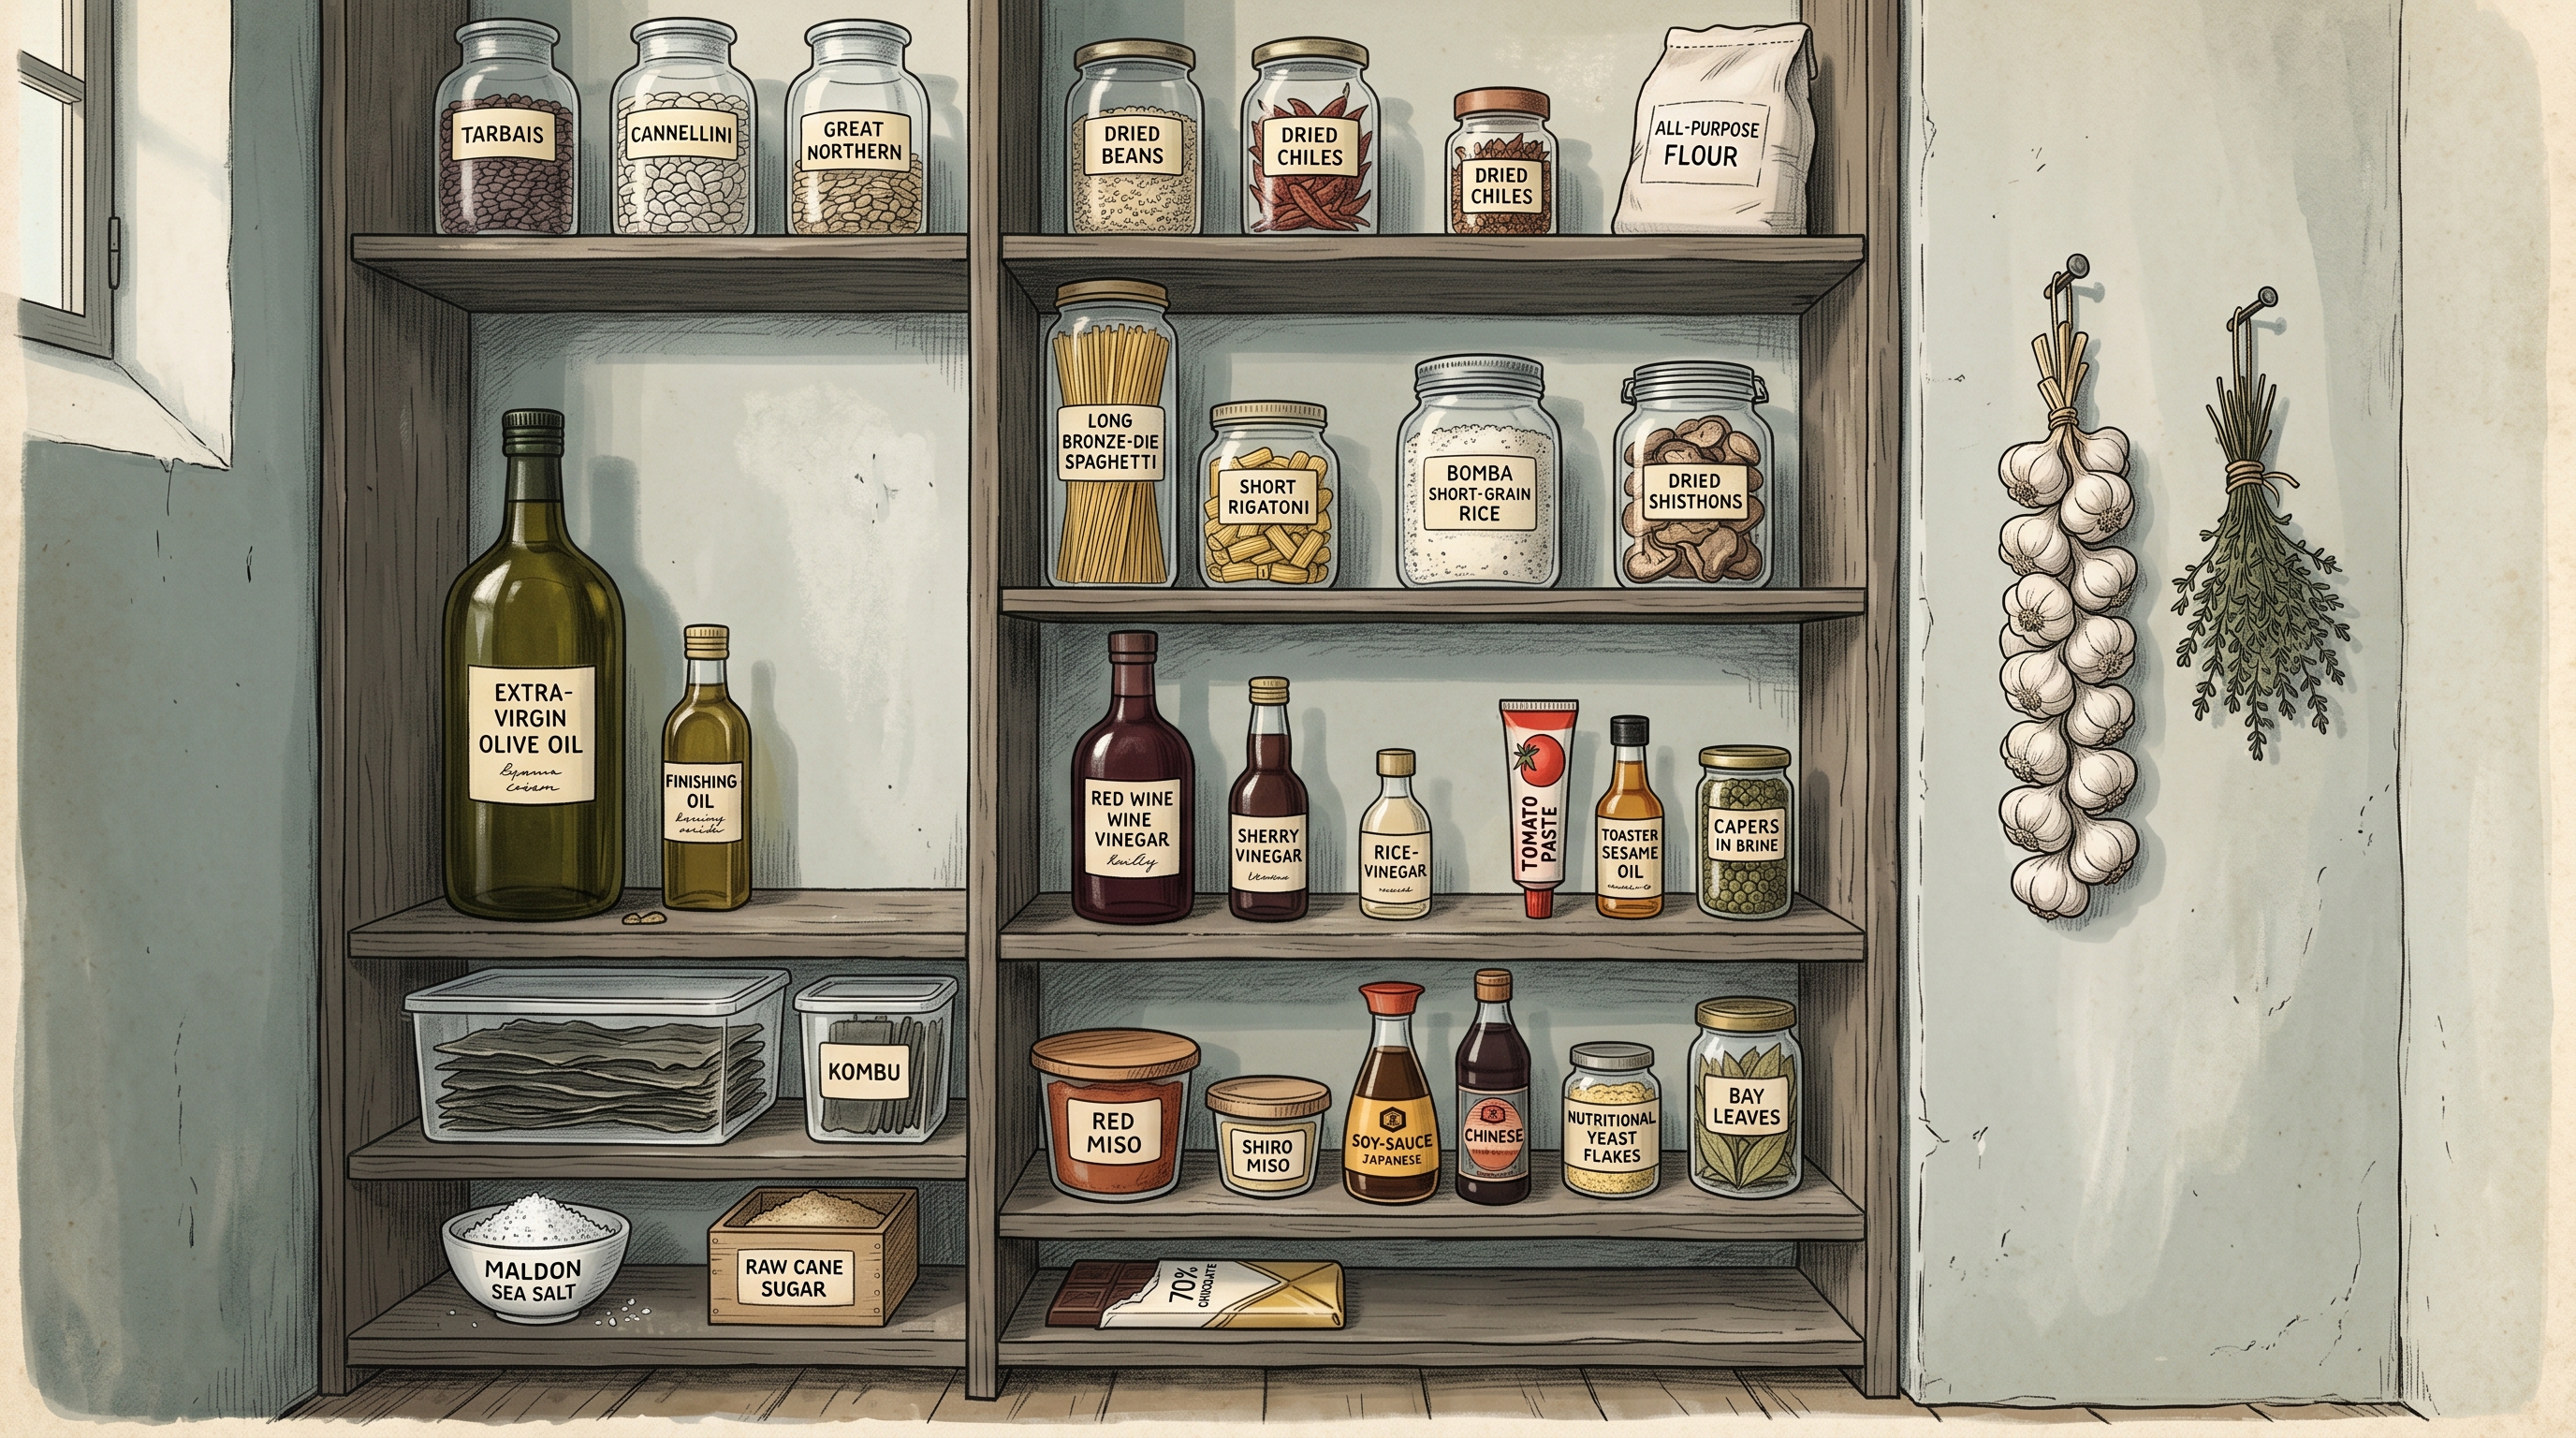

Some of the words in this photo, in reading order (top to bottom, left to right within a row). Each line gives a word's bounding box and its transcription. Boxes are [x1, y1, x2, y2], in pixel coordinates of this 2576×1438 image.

[461, 125, 544, 144] TARBAIS
[631, 125, 732, 144] CANNELLINI
[824, 120, 885, 138] GREAT
[1105, 125, 1160, 142] DRIED
[1281, 126, 1338, 143] DRIED
[1654, 120, 1760, 139] ALL-PURPOSE
[807, 142, 901, 161] NORTHERN
[1102, 147, 1164, 165] BEANS
[1277, 149, 1343, 167] CHILES
[1664, 143, 1738, 168] FLOUR
[1475, 167, 1528, 183] DRIED
[1471, 188, 1533, 205] CHILES
[1088, 413, 1133, 429] LONG
[1062, 433, 1159, 449] BRONZE-DIE
[1065, 453, 1157, 470] SPAGHETTI
[1447, 464, 1514, 482] BOMBA
[1669, 473, 1721, 489] DRIED
[1239, 478, 1296, 495] SHORT
[1428, 487, 1531, 501] SHORT-GRAIN
[1228, 499, 1310, 515] RIGATONI
[1648, 493, 1743, 509] SHISTHONS
[1459, 505, 1500, 521] RICE
[495, 682, 573, 702] EXTRA-
[494, 709, 566, 728] VIRGIN
[478, 734, 539, 755] OLIVE
[548, 735, 584, 755] OIL
[666, 773, 738, 789] FINISHING
[687, 793, 715, 809] OIL
[1091, 790, 1124, 807] RED
[1130, 790, 1174, 807] WINE
[1107, 812, 1151, 828] WINE
[1714, 818, 1779, 834] CAPERS
[1094, 831, 1170, 847] VINEGAR
[1237, 828, 1300, 844] SHERRY
[1521, 796, 1538, 873] TOMATO
[1540, 806, 1558, 862] PASTE
[1601, 828, 1659, 843] TOASTER
[1374, 844, 1419, 860] RICE-
[1602, 845, 1659, 860] SESAME
[1716, 837, 1731, 852] IN
[1736, 838, 1778, 853] BRINE
[1235, 847, 1303, 864] VINEGAR
[1364, 863, 1427, 879] VINEGAR
[1617, 864, 1645, 879] OIL
[828, 1062, 900, 1081] KOMBU
[1729, 1087, 1765, 1105] BAY
[1092, 1111, 1134, 1131] RED
[1568, 1109, 1657, 1127] NUTRITIONAL
[1714, 1108, 1781, 1126] LEAVES
[1352, 1131, 1434, 1152] SOY-SAUCE
[1462, 1125, 1526, 1146] CHINESE
[1587, 1130, 1638, 1146] YEAST
[1087, 1135, 1142, 1154] MISO
[1242, 1139, 1293, 1155] SHIRO
[1362, 1153, 1423, 1167] JAPANESE
[1584, 1148, 1641, 1164] FLAKES
[1247, 1158, 1290, 1173] MISO
[485, 1258, 581, 1281] MALDON
[746, 1258, 788, 1275] RAW
[793, 1259, 843, 1275] CANE
[491, 1284, 527, 1301] SEA
[532, 1283, 577, 1302] SALT
[761, 1280, 827, 1298] SUGAR
[1168, 1266, 1199, 1303] 70%
